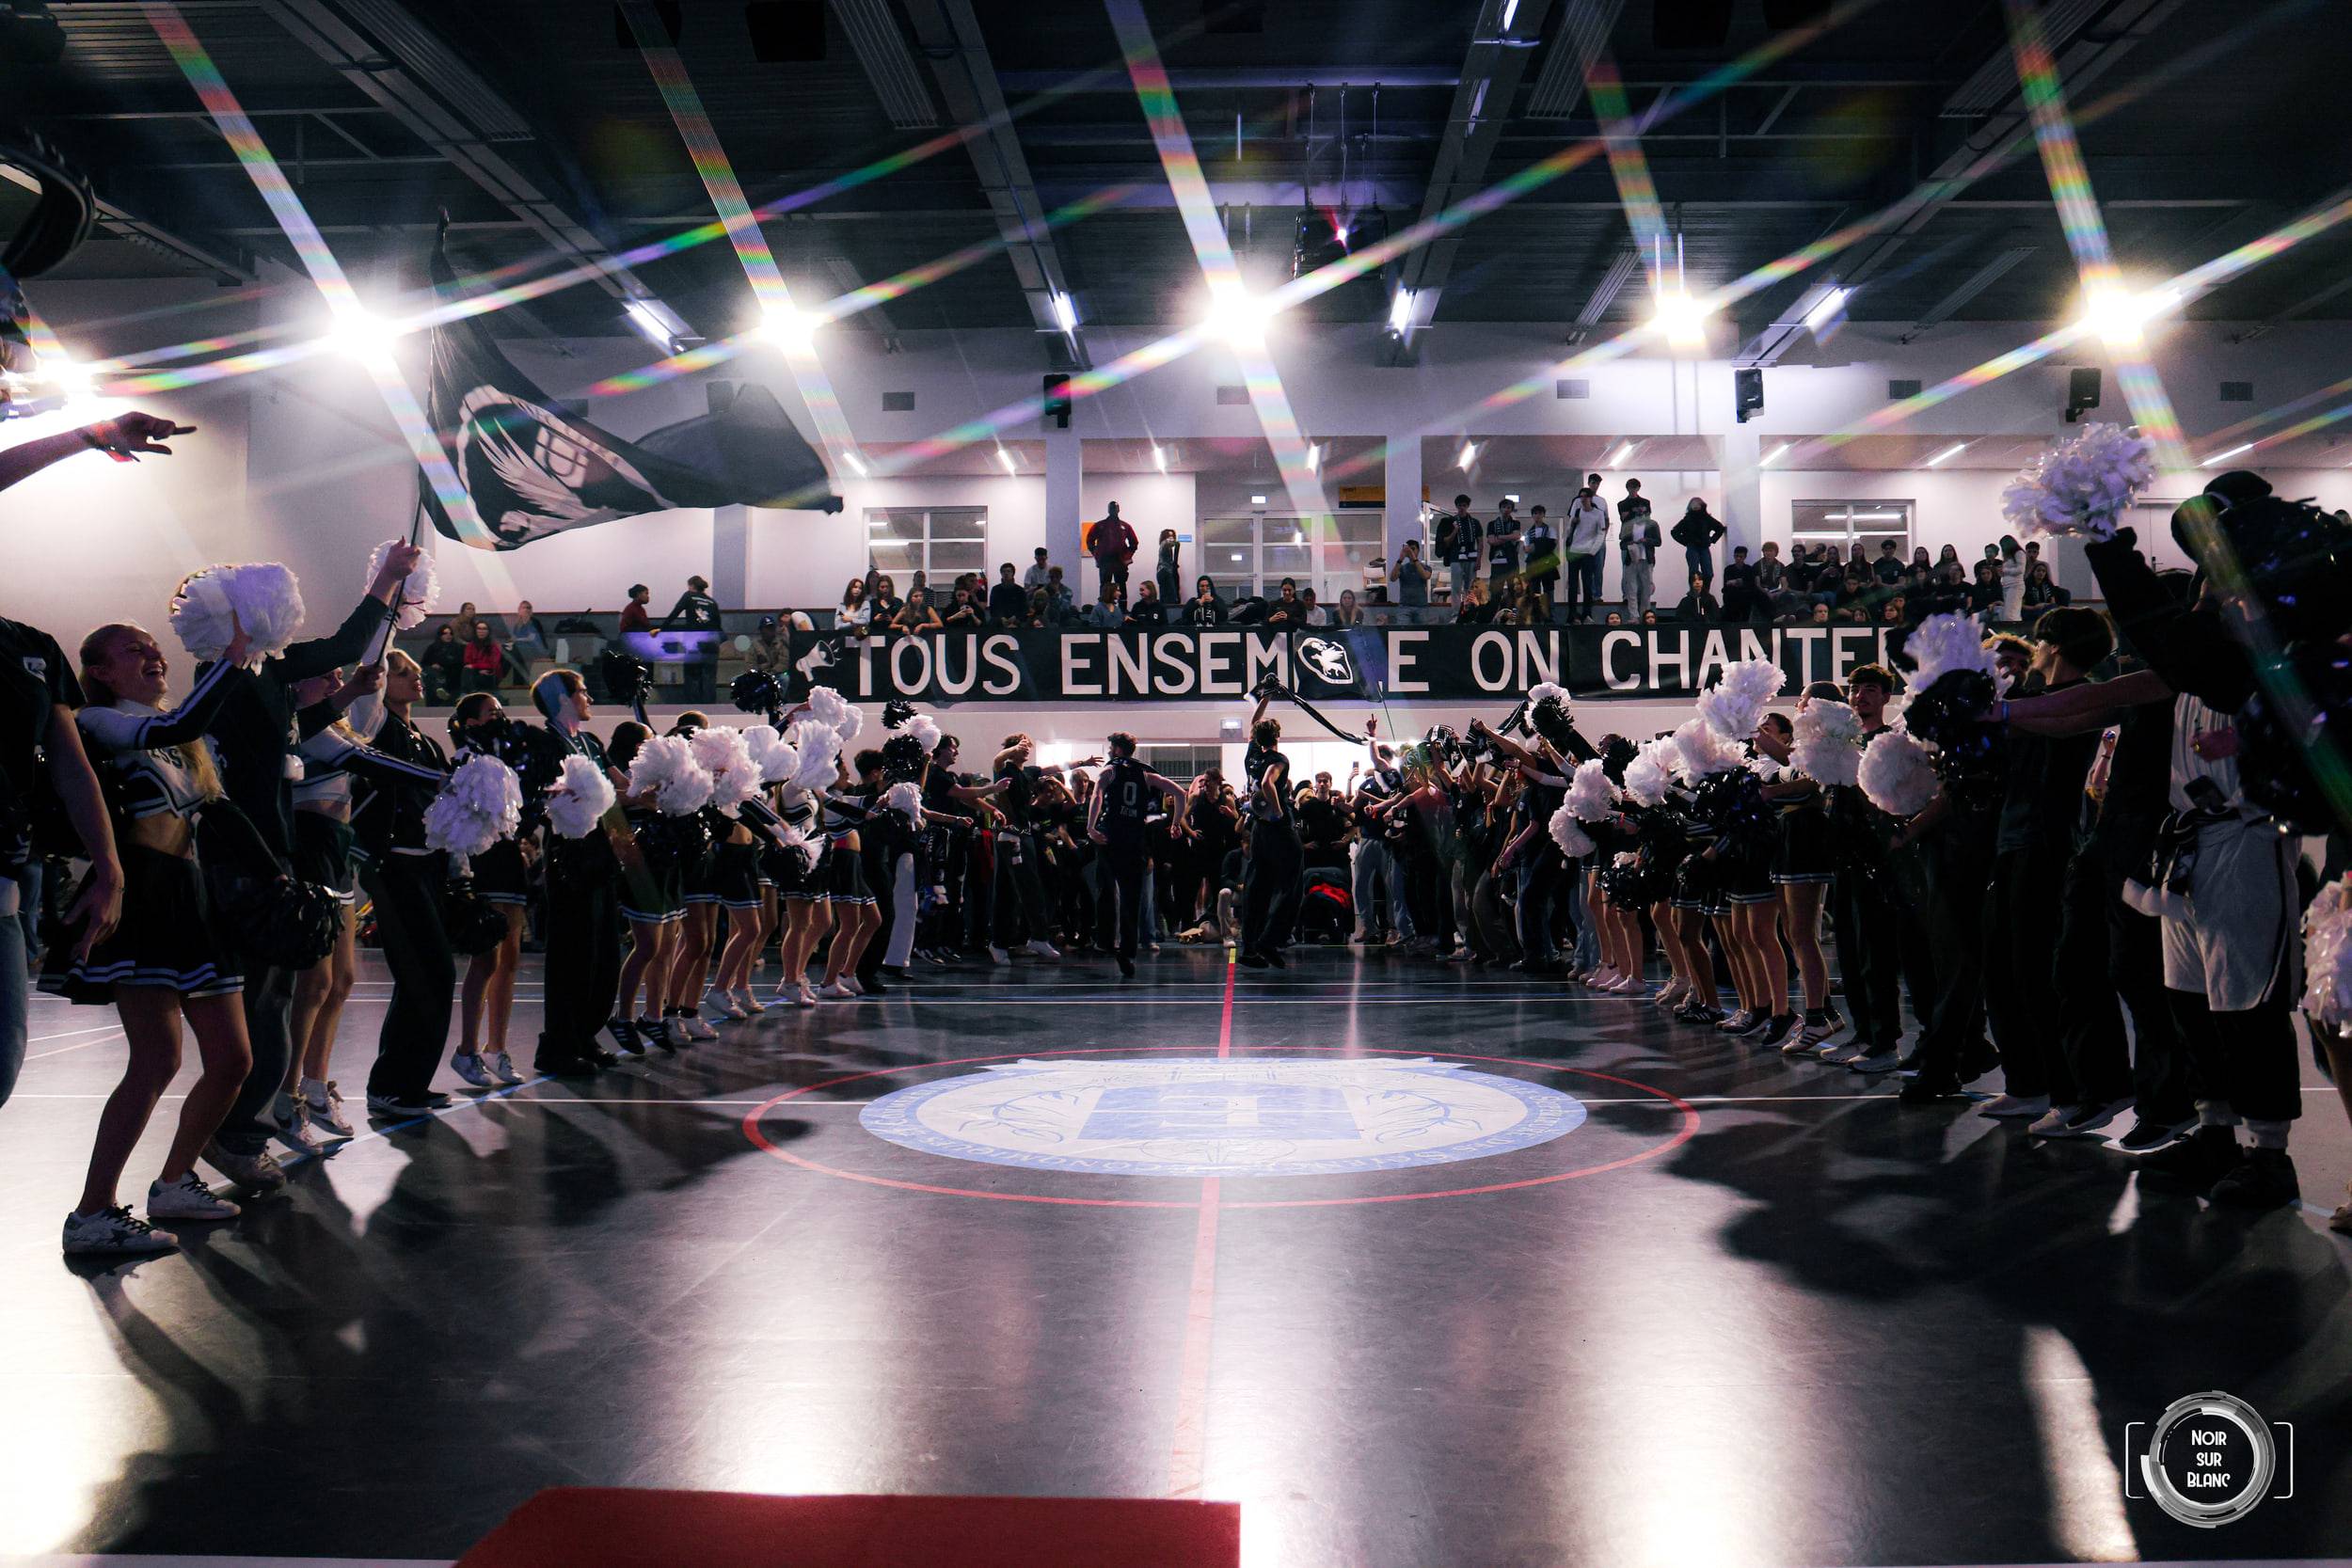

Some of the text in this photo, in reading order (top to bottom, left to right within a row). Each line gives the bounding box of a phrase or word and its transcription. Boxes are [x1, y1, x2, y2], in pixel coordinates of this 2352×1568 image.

[844, 632, 1021, 696] TOUS
[1062, 631, 1429, 694] ENSEME
[1470, 629, 1560, 692] ON
[1123, 782, 1136, 805] 0
